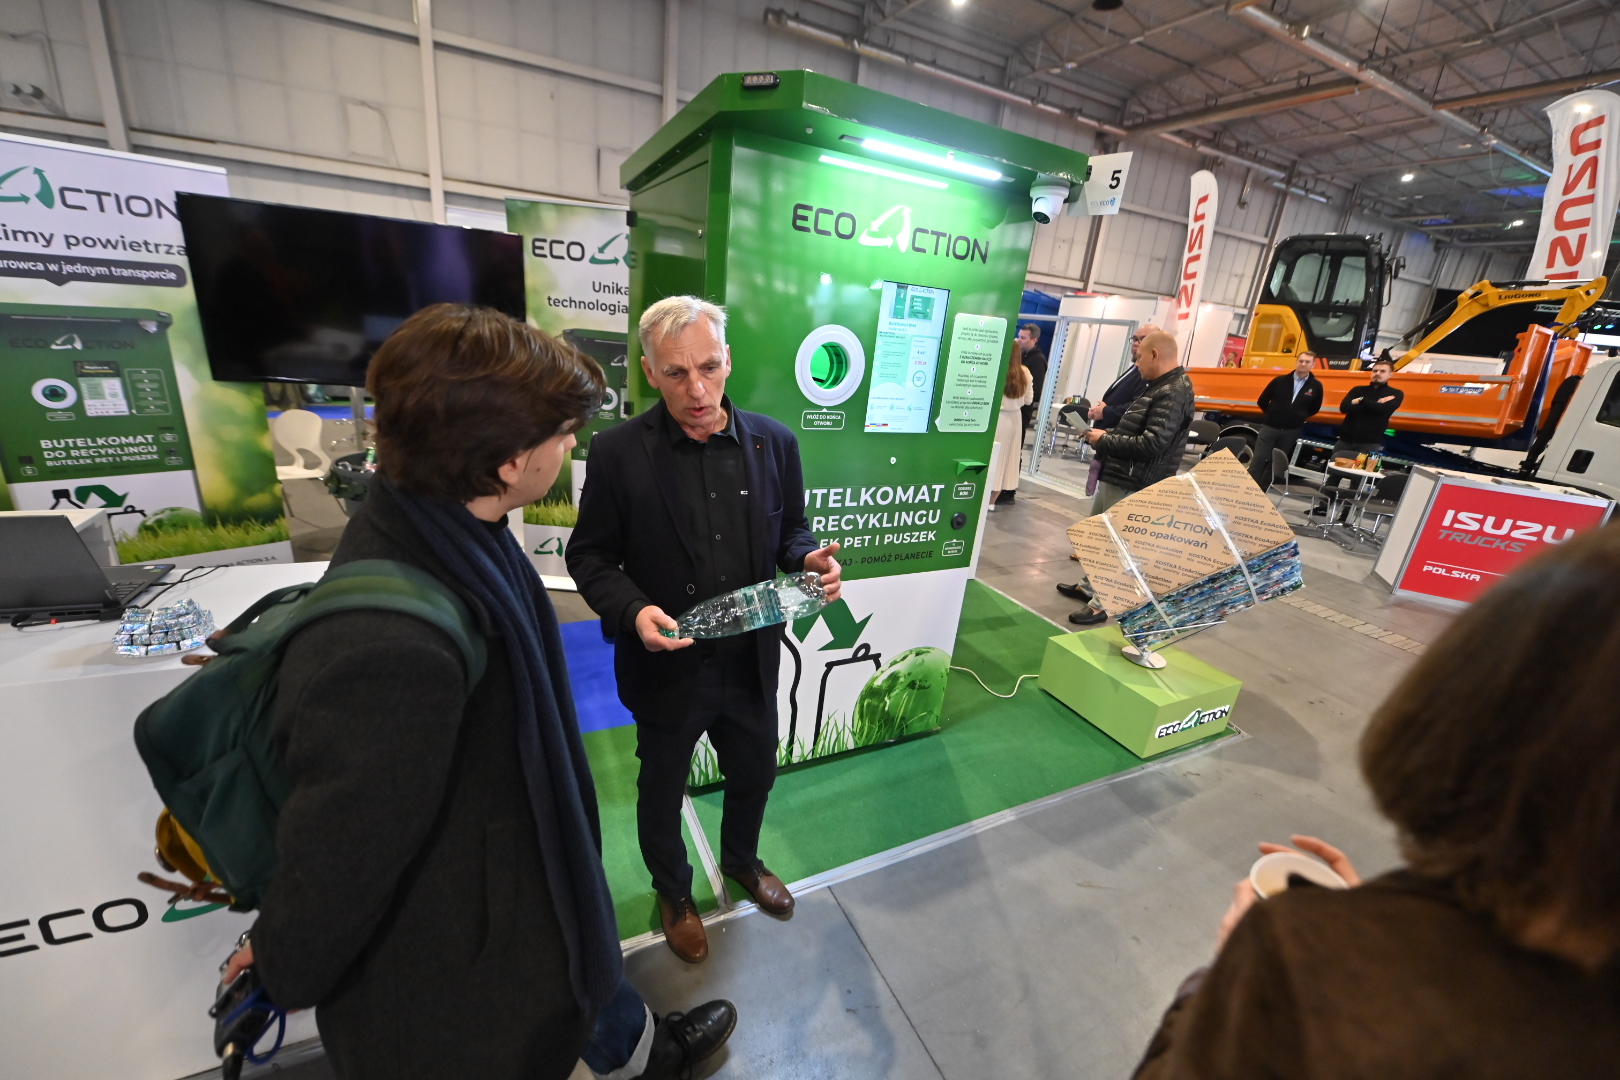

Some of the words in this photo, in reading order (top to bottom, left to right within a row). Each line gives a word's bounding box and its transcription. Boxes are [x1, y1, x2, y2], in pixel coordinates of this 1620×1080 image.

[1108, 170, 1122, 189] 5
[47, 263, 59, 272] w
[61, 261, 110, 277] jednym
[110, 266, 177, 281] transporcie
[547, 295, 629, 316] technologia
[40, 434, 155, 448] BUTELKOMAT
[43, 450, 66, 458] DO
[70, 445, 158, 458] RECYKLINGU
[46, 458, 93, 466] BUTELEK
[812, 509, 941, 532] RECYKLINGU
[1234, 516, 1259, 524] KOSTKA
[1442, 509, 1576, 545] ISUZU
[844, 536, 872, 548] PET
[875, 535, 880, 546] I
[884, 530, 937, 545] PUSZEK
[1122, 525, 1148, 536] 2000
[1150, 531, 1208, 550] opakowań
[1438, 530, 1528, 552] TRUCKS
[860, 552, 893, 565] POMÓŻ
[894, 550, 934, 562] PLANECIE
[1156, 544, 1183, 554] EcoAction
[1188, 552, 1212, 562] KOSTKA
[1155, 560, 1177, 569] KOSTKA
[1423, 565, 1481, 582] POLSKA
